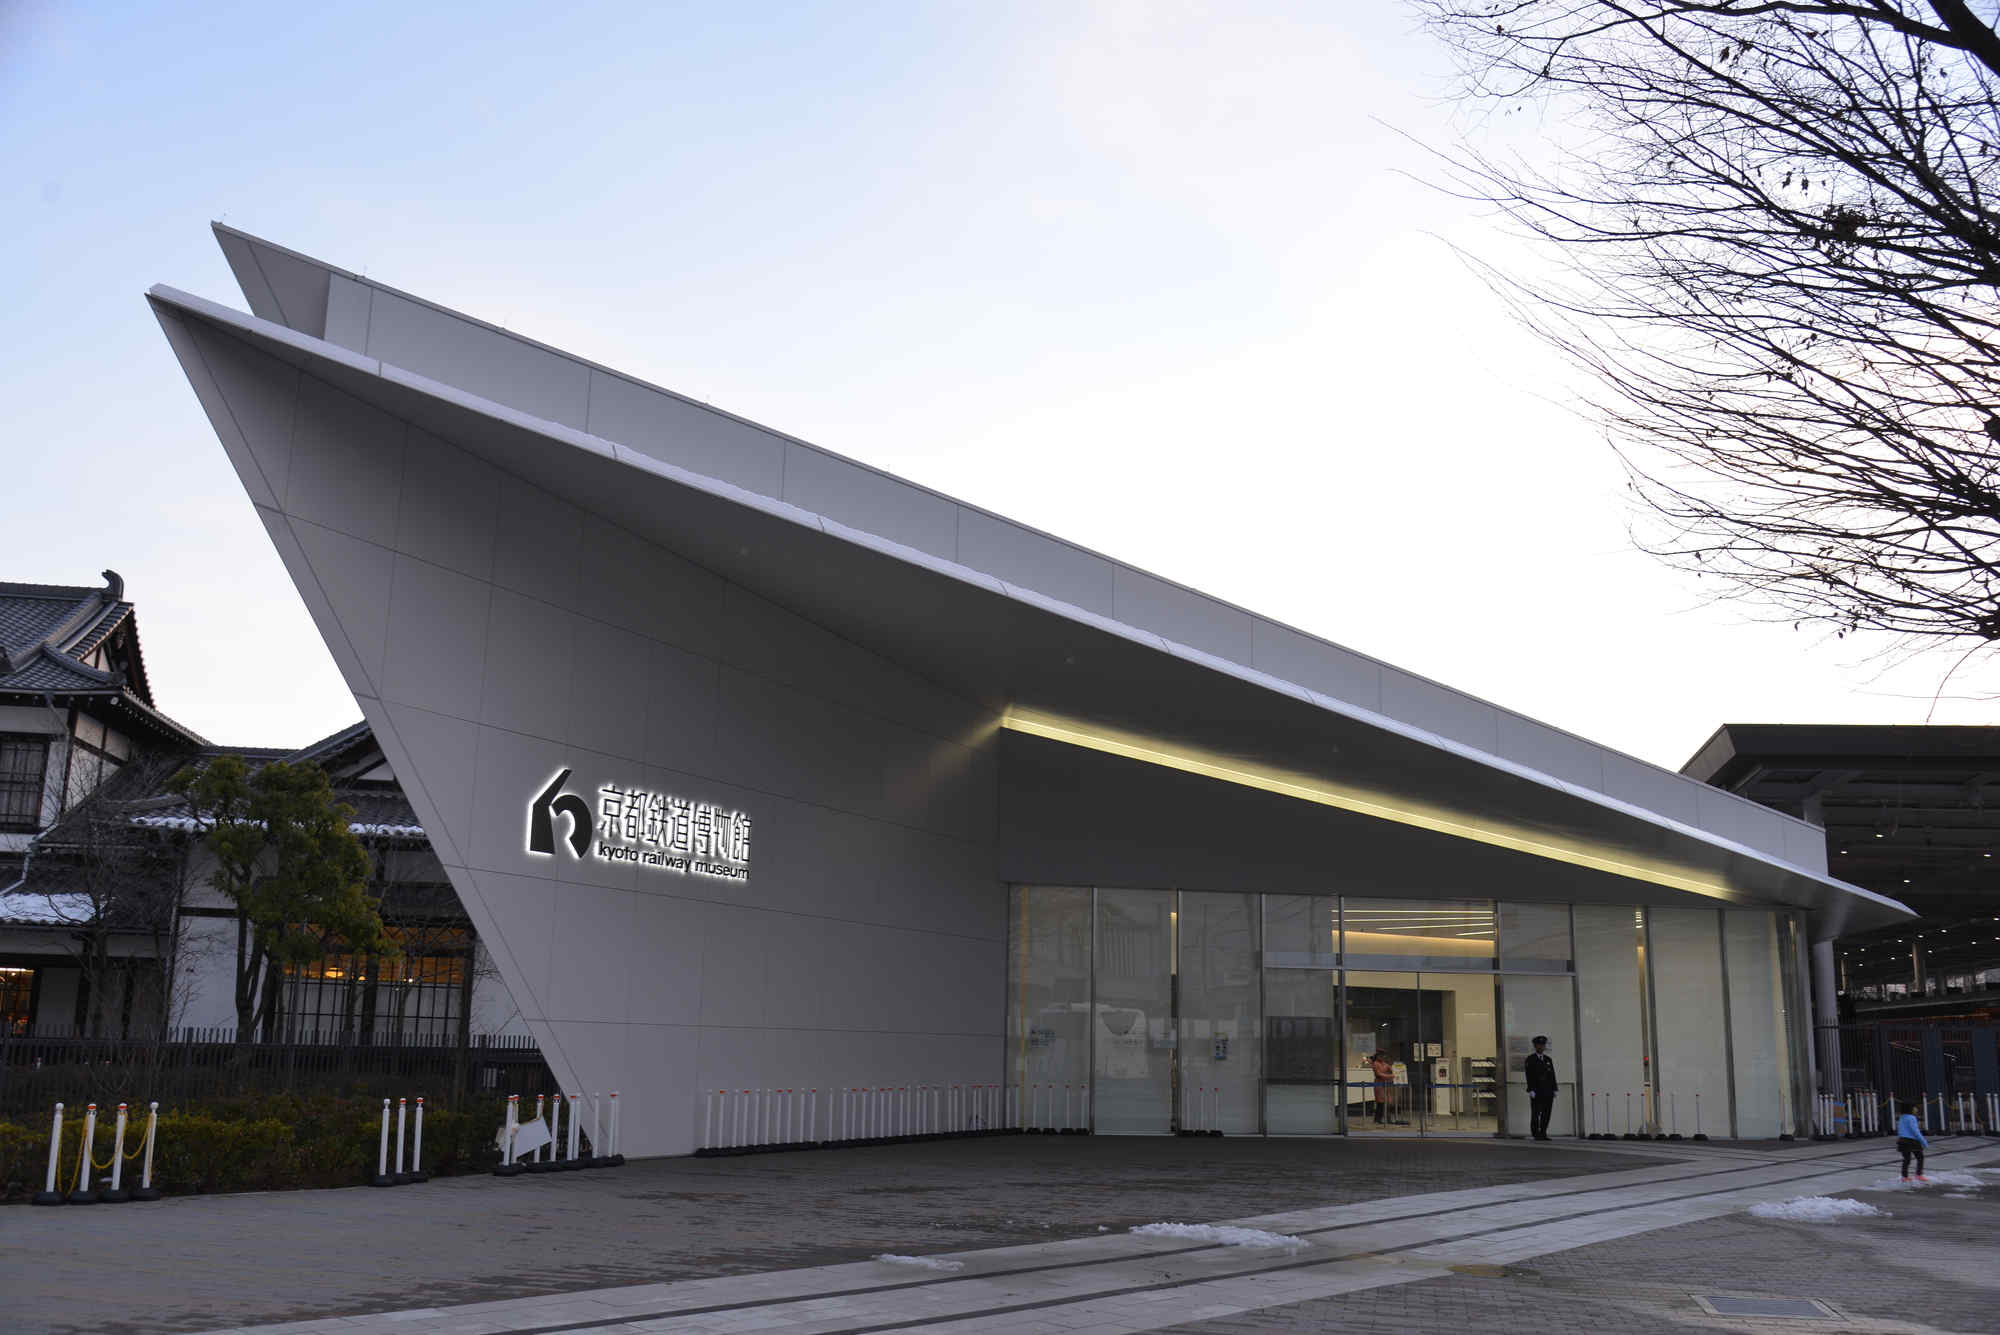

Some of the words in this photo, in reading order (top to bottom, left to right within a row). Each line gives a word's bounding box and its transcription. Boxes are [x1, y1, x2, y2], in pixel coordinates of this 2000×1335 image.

[600, 785, 752, 862] 京都鉄道博物館
[598, 841, 639, 861] kyoto
[642, 851, 691, 873] railway
[695, 861, 750, 880] museum
